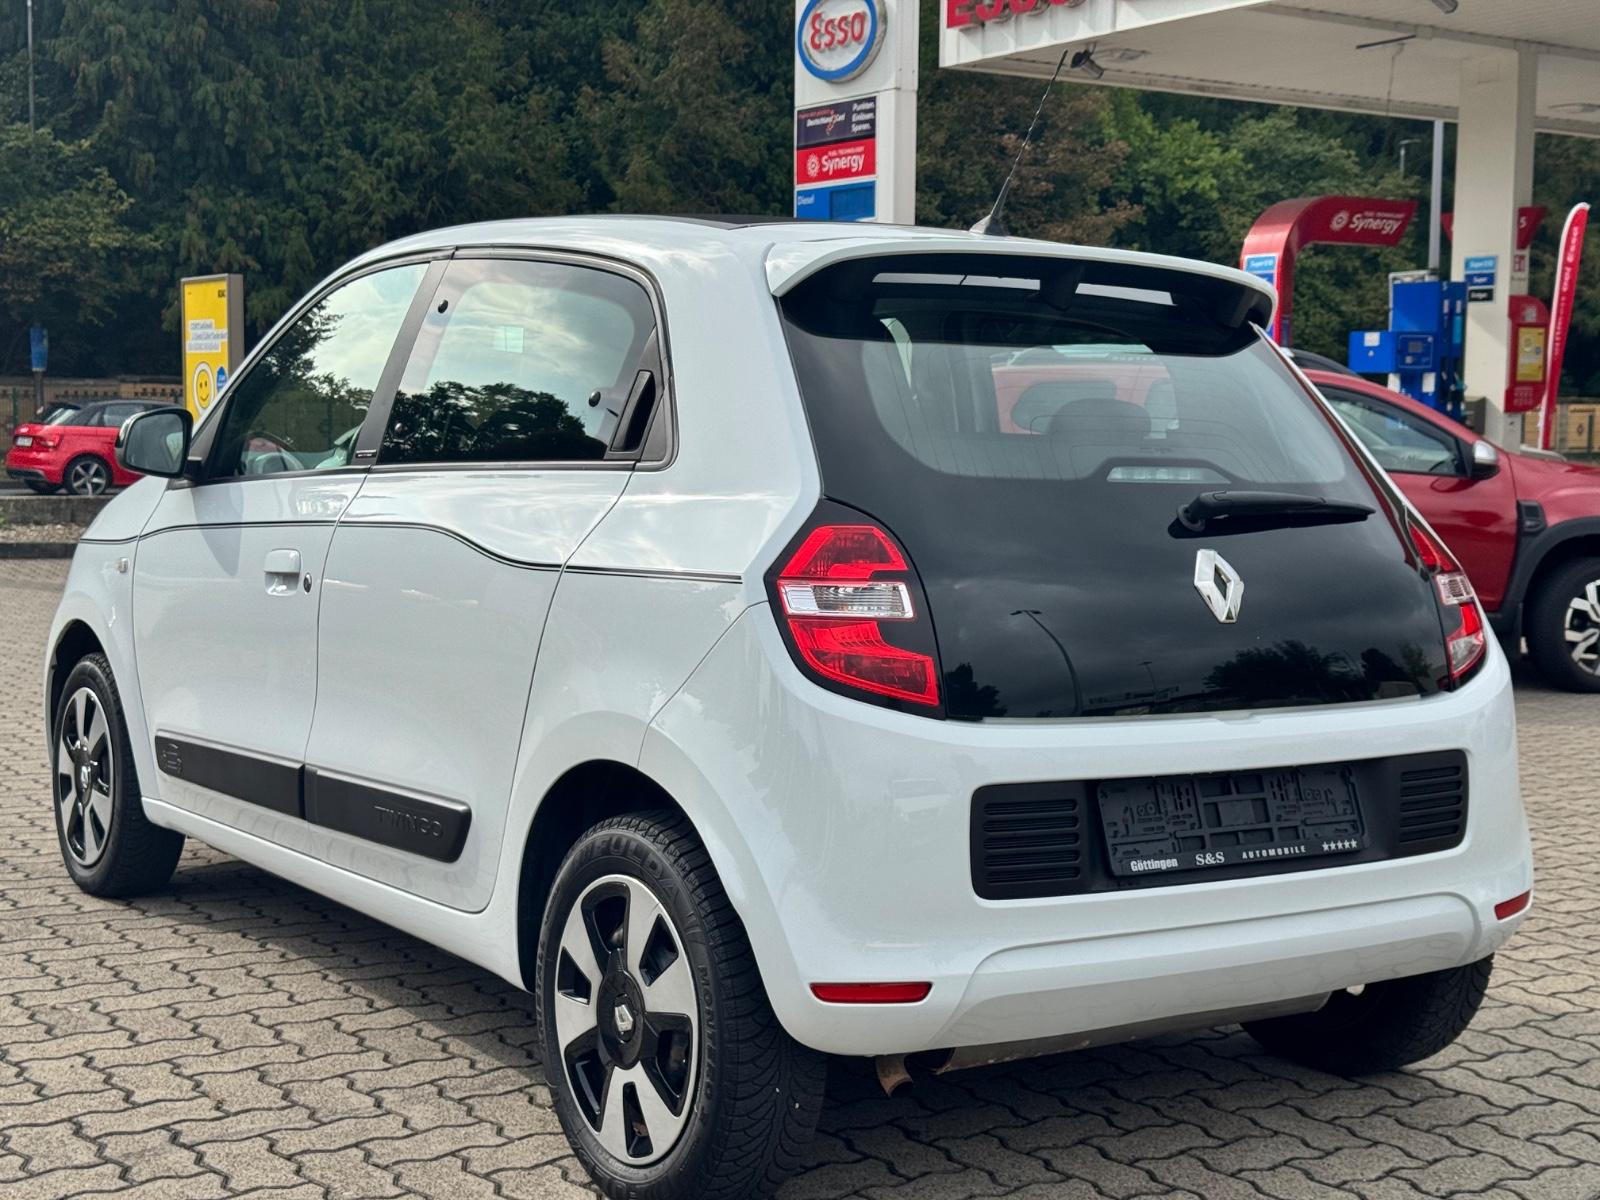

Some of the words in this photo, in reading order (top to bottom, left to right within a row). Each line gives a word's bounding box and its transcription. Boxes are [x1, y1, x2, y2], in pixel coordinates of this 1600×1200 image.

[821, 154, 865, 176] Synergy
[1348, 213, 1402, 235] Synergy
[374, 805, 442, 837] TWINGO
[1130, 857, 1179, 872] Göttingen
[1195, 850, 1226, 866] S&S
[1241, 845, 1307, 860] AUTOMOBILE
